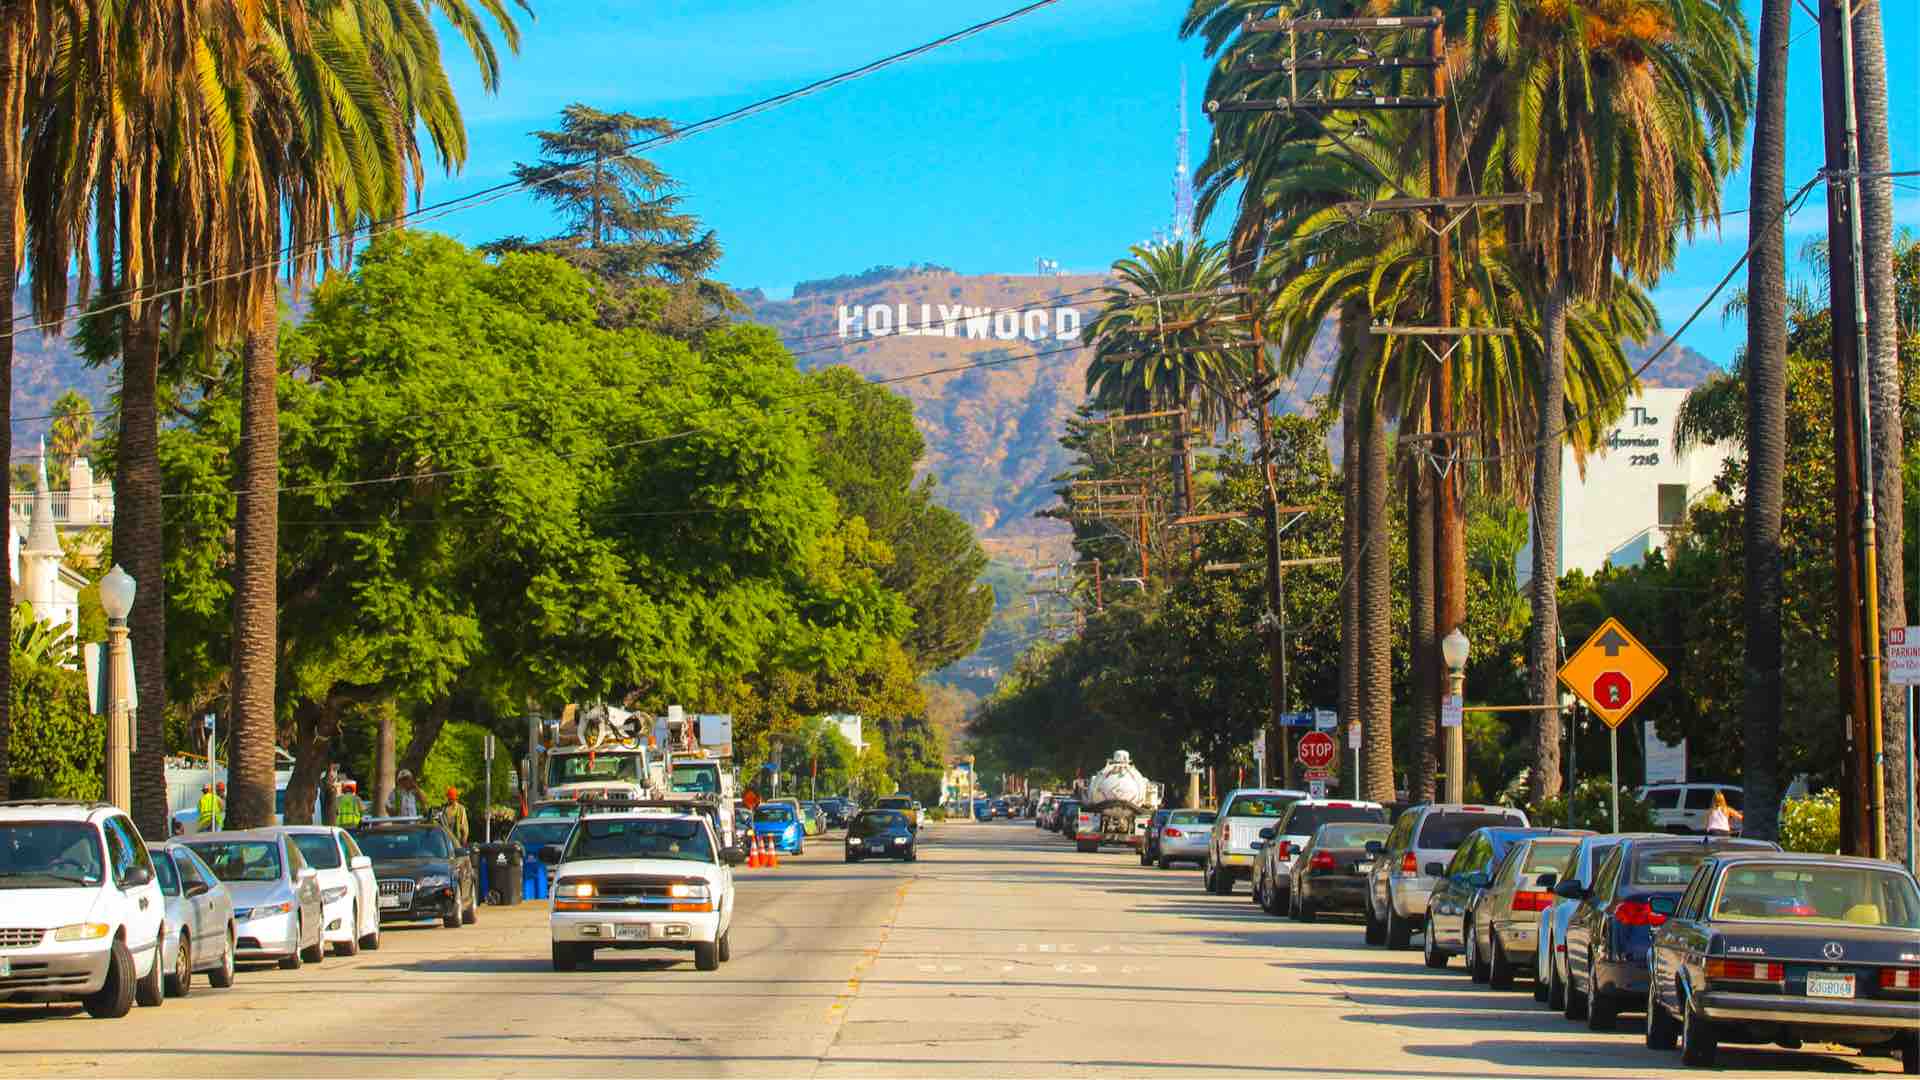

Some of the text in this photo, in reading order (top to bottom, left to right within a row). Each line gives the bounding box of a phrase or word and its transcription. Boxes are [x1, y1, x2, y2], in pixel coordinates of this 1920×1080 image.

[838, 303, 1081, 341] HOLLYWOOD
[1630, 407, 1658, 426] The
[1630, 452, 1660, 466] 2218
[1890, 630, 1904, 643] NO
[1301, 743, 1332, 758] STOP
